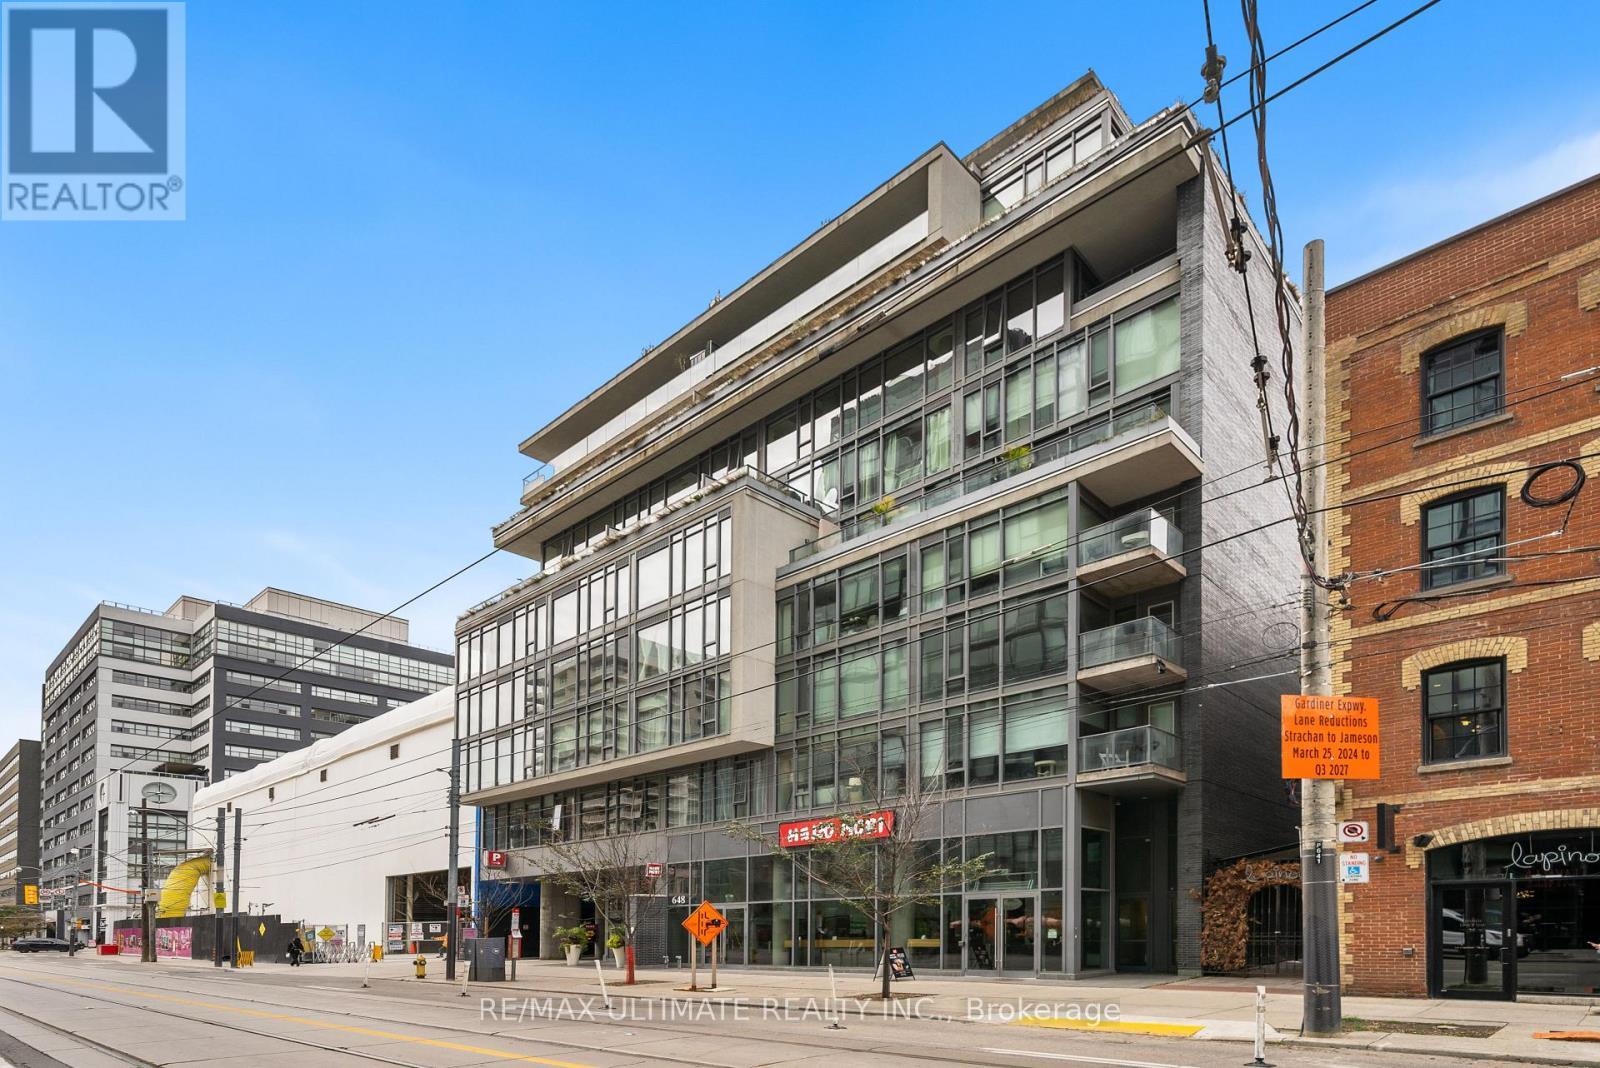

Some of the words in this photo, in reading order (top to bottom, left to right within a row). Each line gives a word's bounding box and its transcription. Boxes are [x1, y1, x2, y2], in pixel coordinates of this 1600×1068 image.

[1295, 698, 1334, 710] Gardiner
[1338, 699, 1367, 714] Expwy.
[1294, 714, 1315, 726] Lane
[1319, 715, 1368, 728] Reductions
[1284, 730, 1324, 743] Strachan
[1327, 731, 1336, 743] to
[1340, 732, 1378, 744] Jameson
[1292, 747, 1319, 759] March
[1338, 748, 1358, 760] 2024
[1361, 749, 1370, 760] to
[1315, 764, 1326, 776] Q3
[1329, 764, 1349, 776] 2027
[493, 853, 501, 861] P
[671, 895, 686, 904] 648
